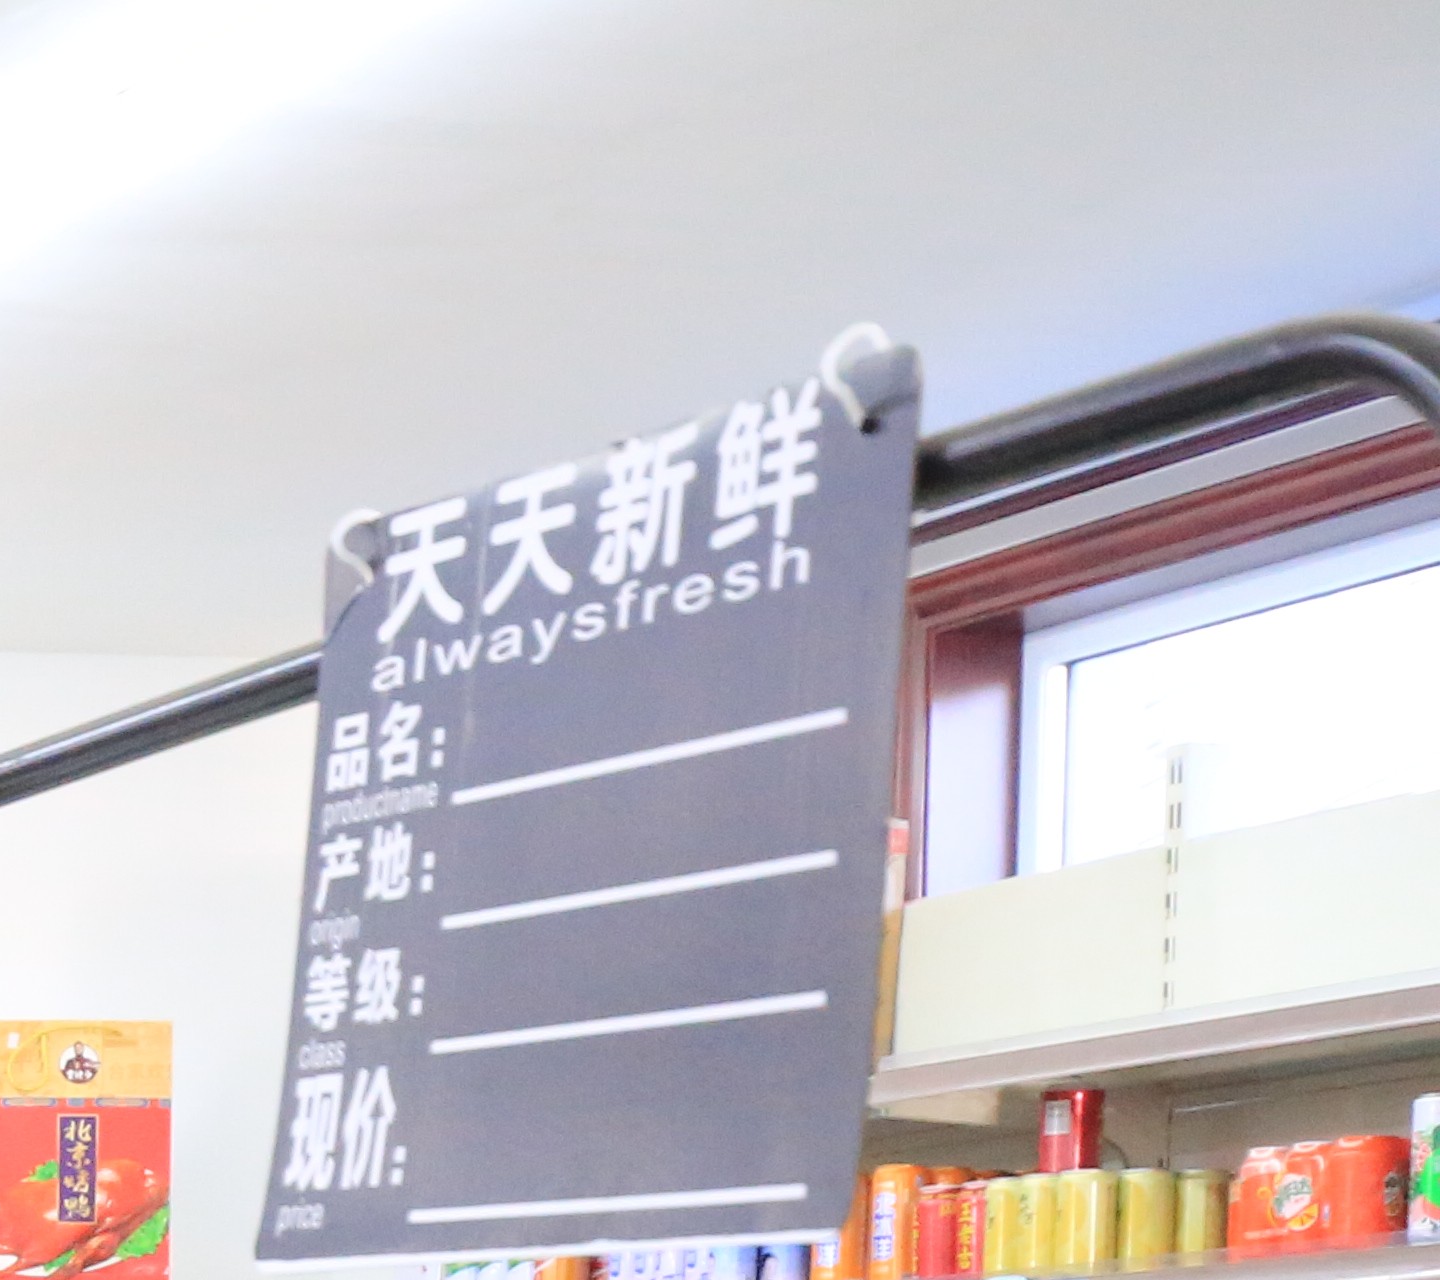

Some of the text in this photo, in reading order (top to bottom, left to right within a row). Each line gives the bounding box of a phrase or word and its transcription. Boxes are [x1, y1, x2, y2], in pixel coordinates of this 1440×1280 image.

[377, 376, 822, 643] 天天新鲜
[370, 541, 811, 692] alwaysfresh
[325, 701, 446, 794] 品名：
[313, 822, 436, 914] 产地：
[303, 947, 425, 1032] 等级：
[283, 1064, 407, 1191] 现价：
